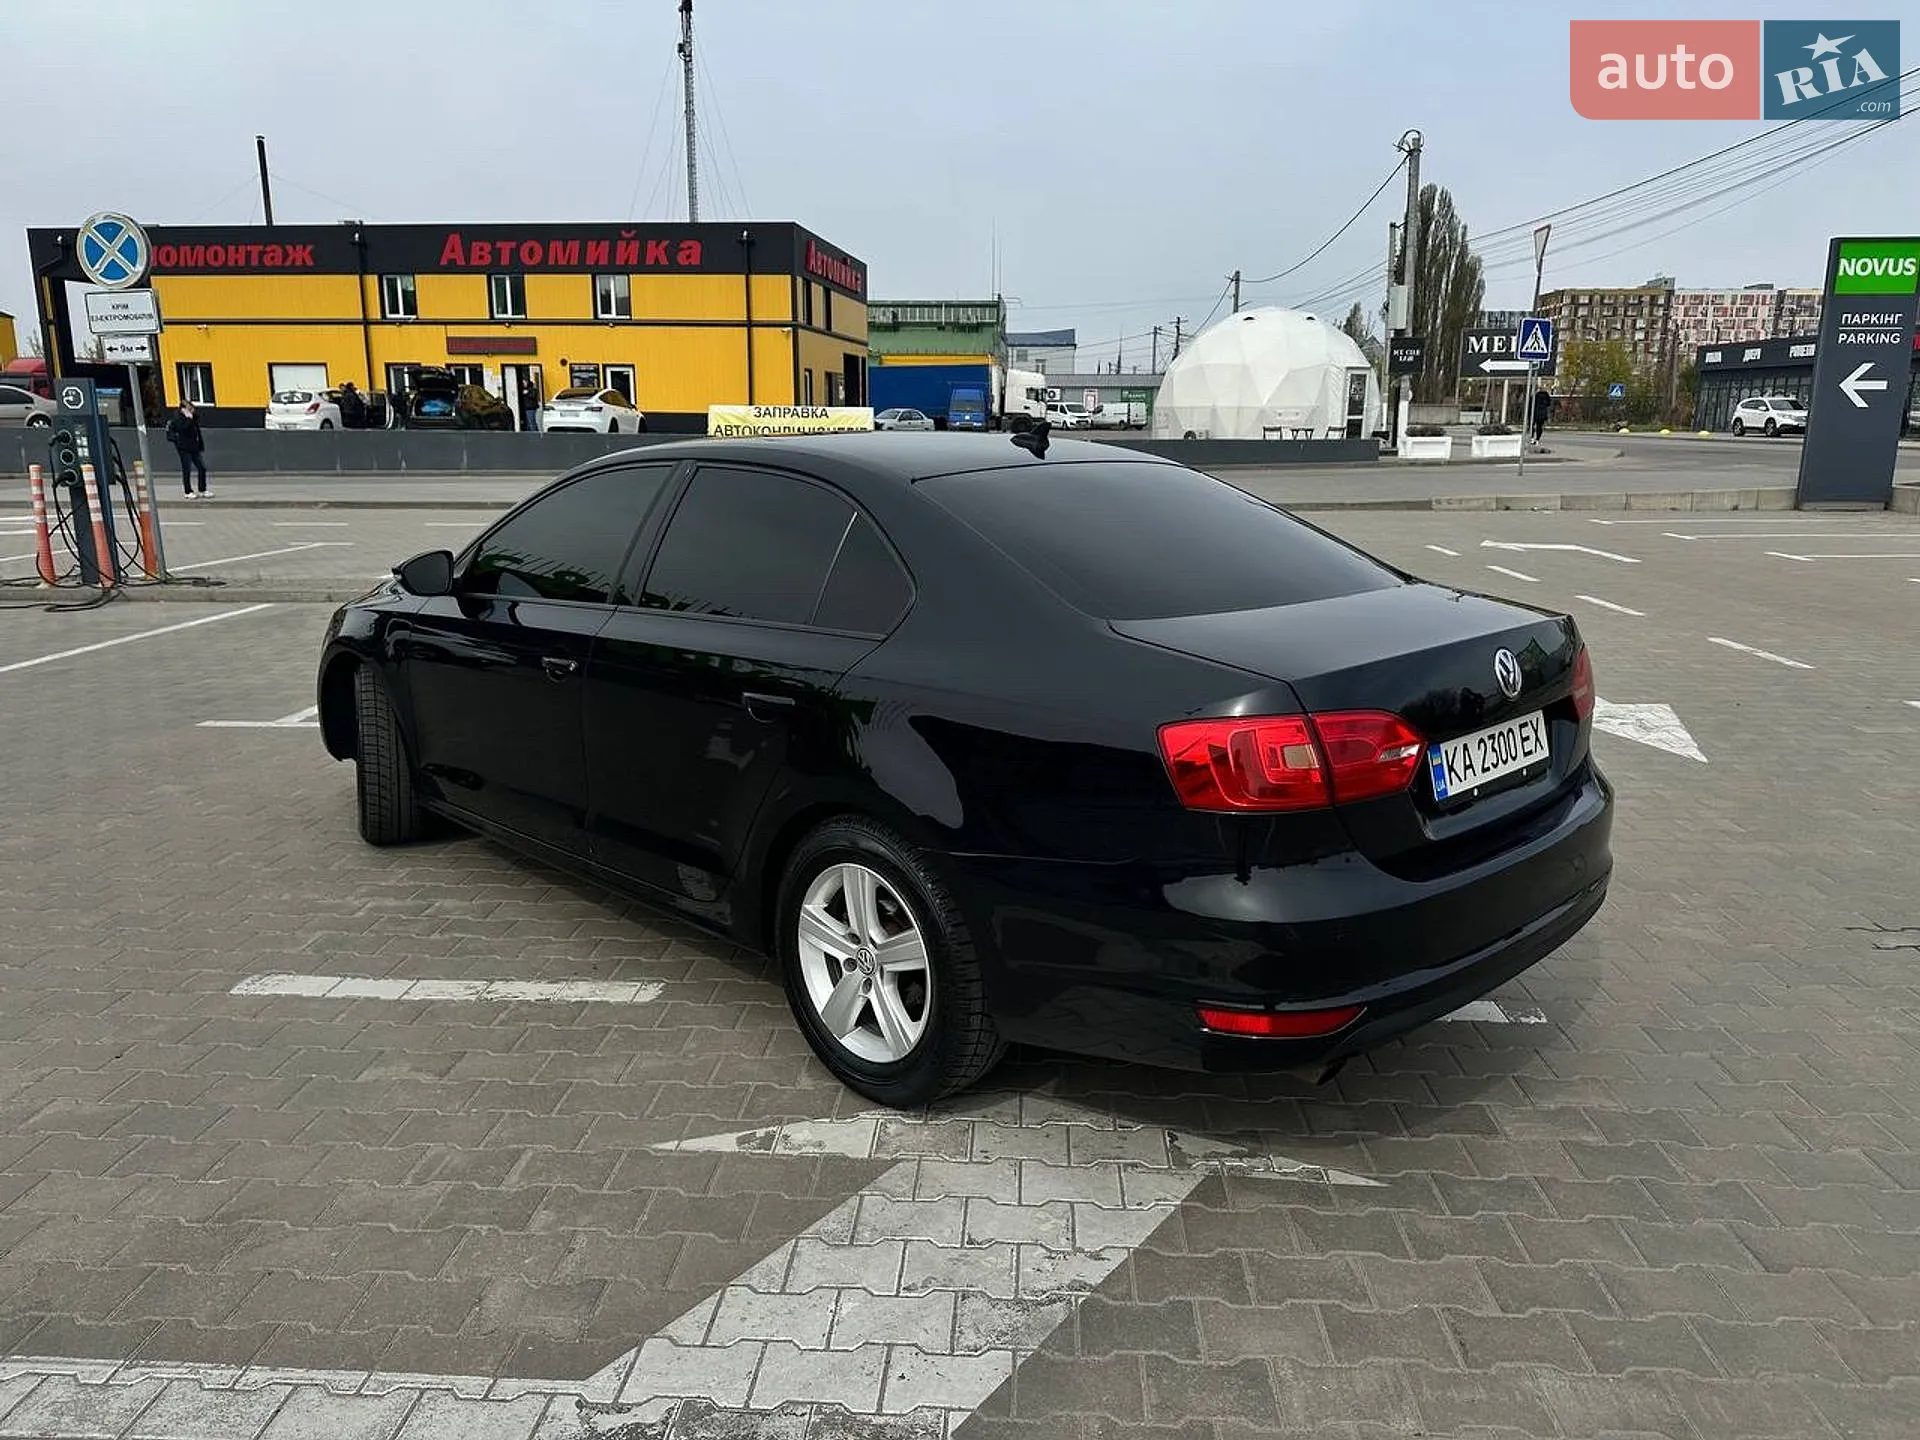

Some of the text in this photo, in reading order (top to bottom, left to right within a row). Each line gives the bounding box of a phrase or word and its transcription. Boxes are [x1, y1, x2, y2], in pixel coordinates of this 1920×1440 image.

[439, 229, 705, 266] Автомийка
[1838, 257, 1917, 277] NOVUS
[1841, 313, 1903, 325] ПАРКІНГ
[1837, 332, 1901, 344] PARKING
[753, 406, 829, 419] ЗАПРАВКА
[1444, 742, 1478, 787] KA
[1477, 727, 1519, 774] 2300
[1518, 716, 1545, 759] EX
